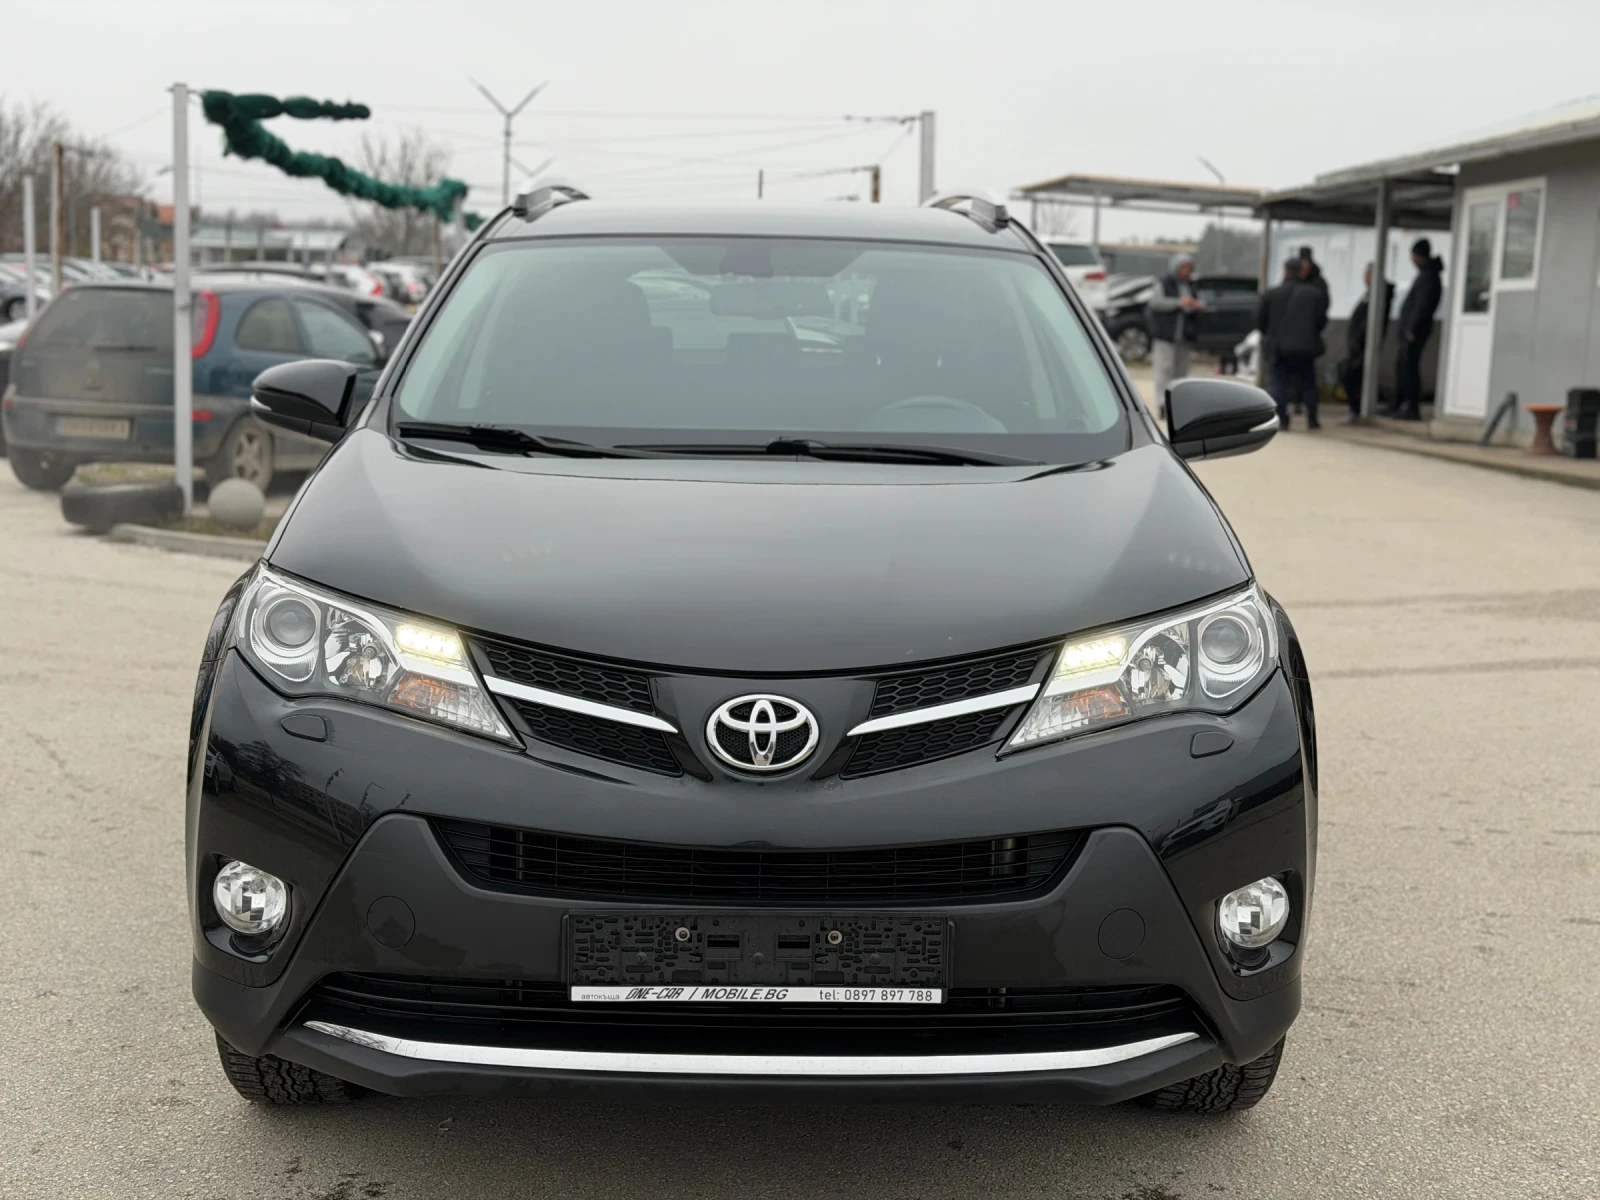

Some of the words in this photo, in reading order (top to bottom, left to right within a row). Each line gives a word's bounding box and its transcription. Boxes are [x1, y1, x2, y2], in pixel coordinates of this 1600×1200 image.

[700, 988, 789, 1000] MOBILE.BG
[819, 989, 840, 1001] tel:
[844, 989, 876, 1001] 0897
[880, 989, 904, 1001] 897
[908, 990, 933, 1002] 788
